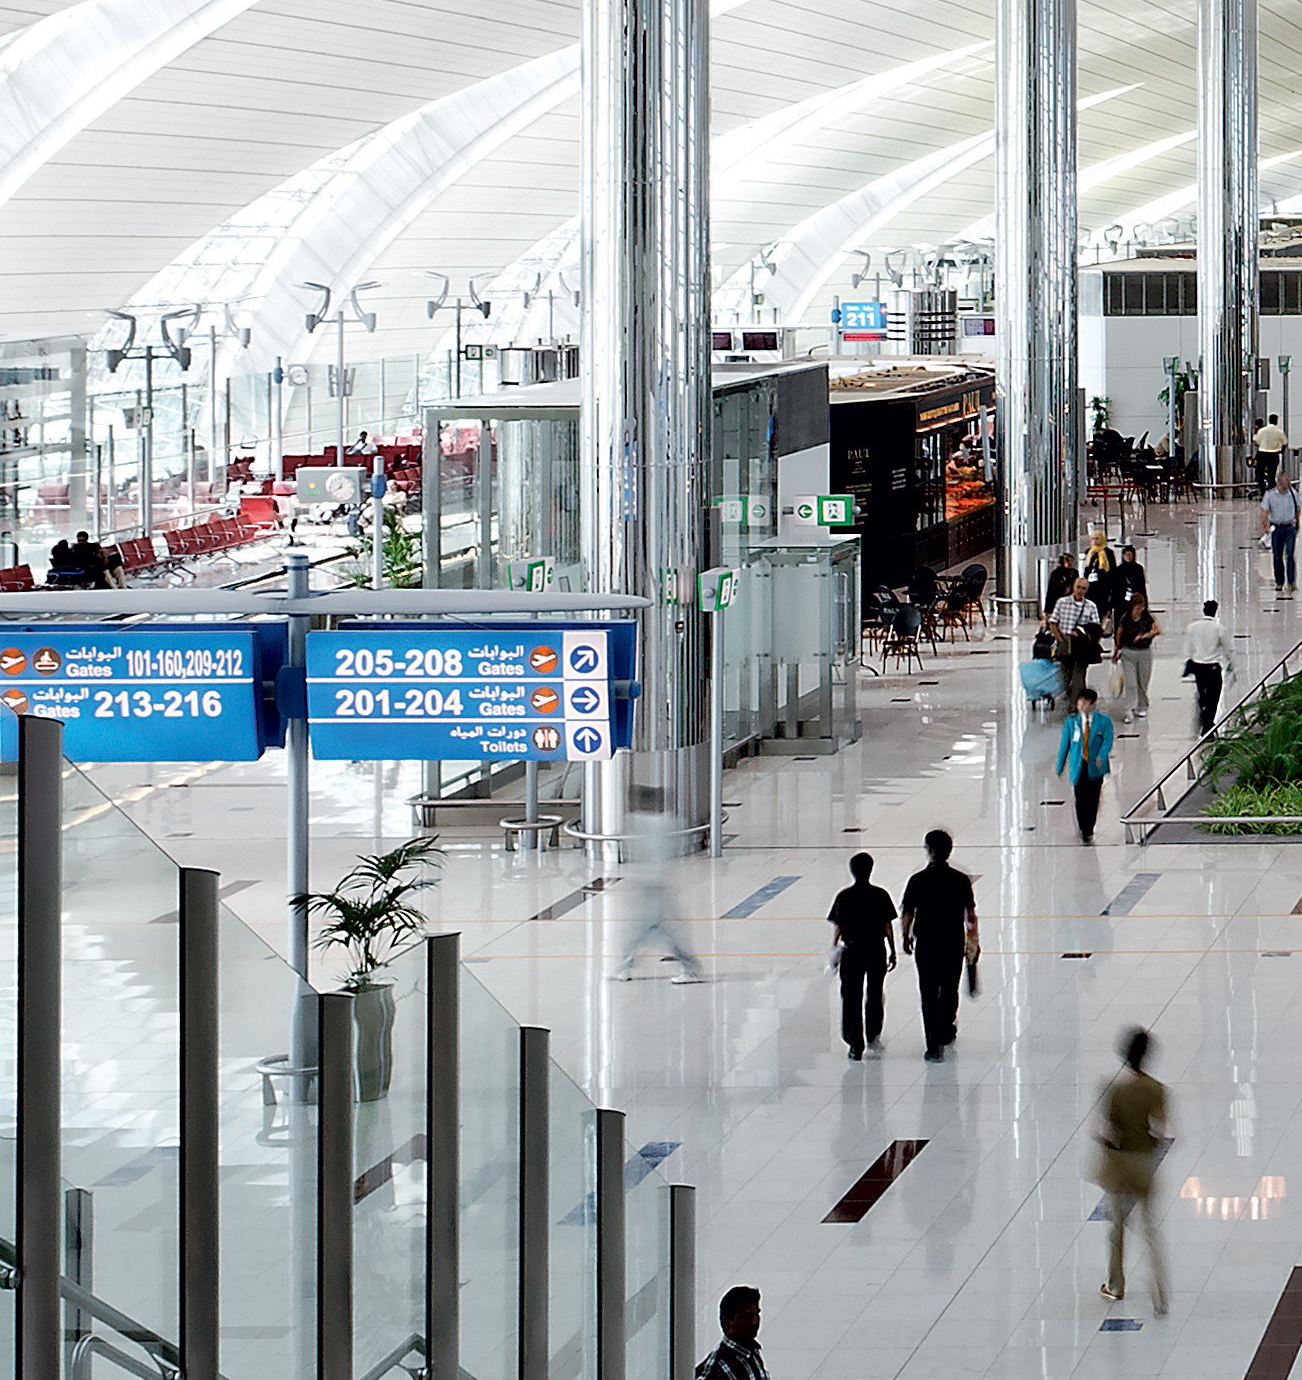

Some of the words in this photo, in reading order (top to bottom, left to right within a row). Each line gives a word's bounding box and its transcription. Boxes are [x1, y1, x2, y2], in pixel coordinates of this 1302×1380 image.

[846, 312, 875, 327] 211
[65, 646, 122, 663] البوابات
[467, 645, 525, 661] البوابات
[126, 649, 244, 679] 101-160,209-212
[334, 648, 464, 677] 205-208
[477, 661, 526, 676] Gates
[65, 663, 113, 678] Gates
[32, 687, 90, 704] البوابات
[468, 685, 526, 702] البوابات
[94, 690, 223, 719] 213-216
[335, 688, 465, 717] 201-204
[478, 702, 527, 717] Gates
[33, 704, 81, 718] Gates
[449, 725, 484, 739] المياه
[487, 725, 528, 740] دورات
[479, 740, 529, 754] Toilets
